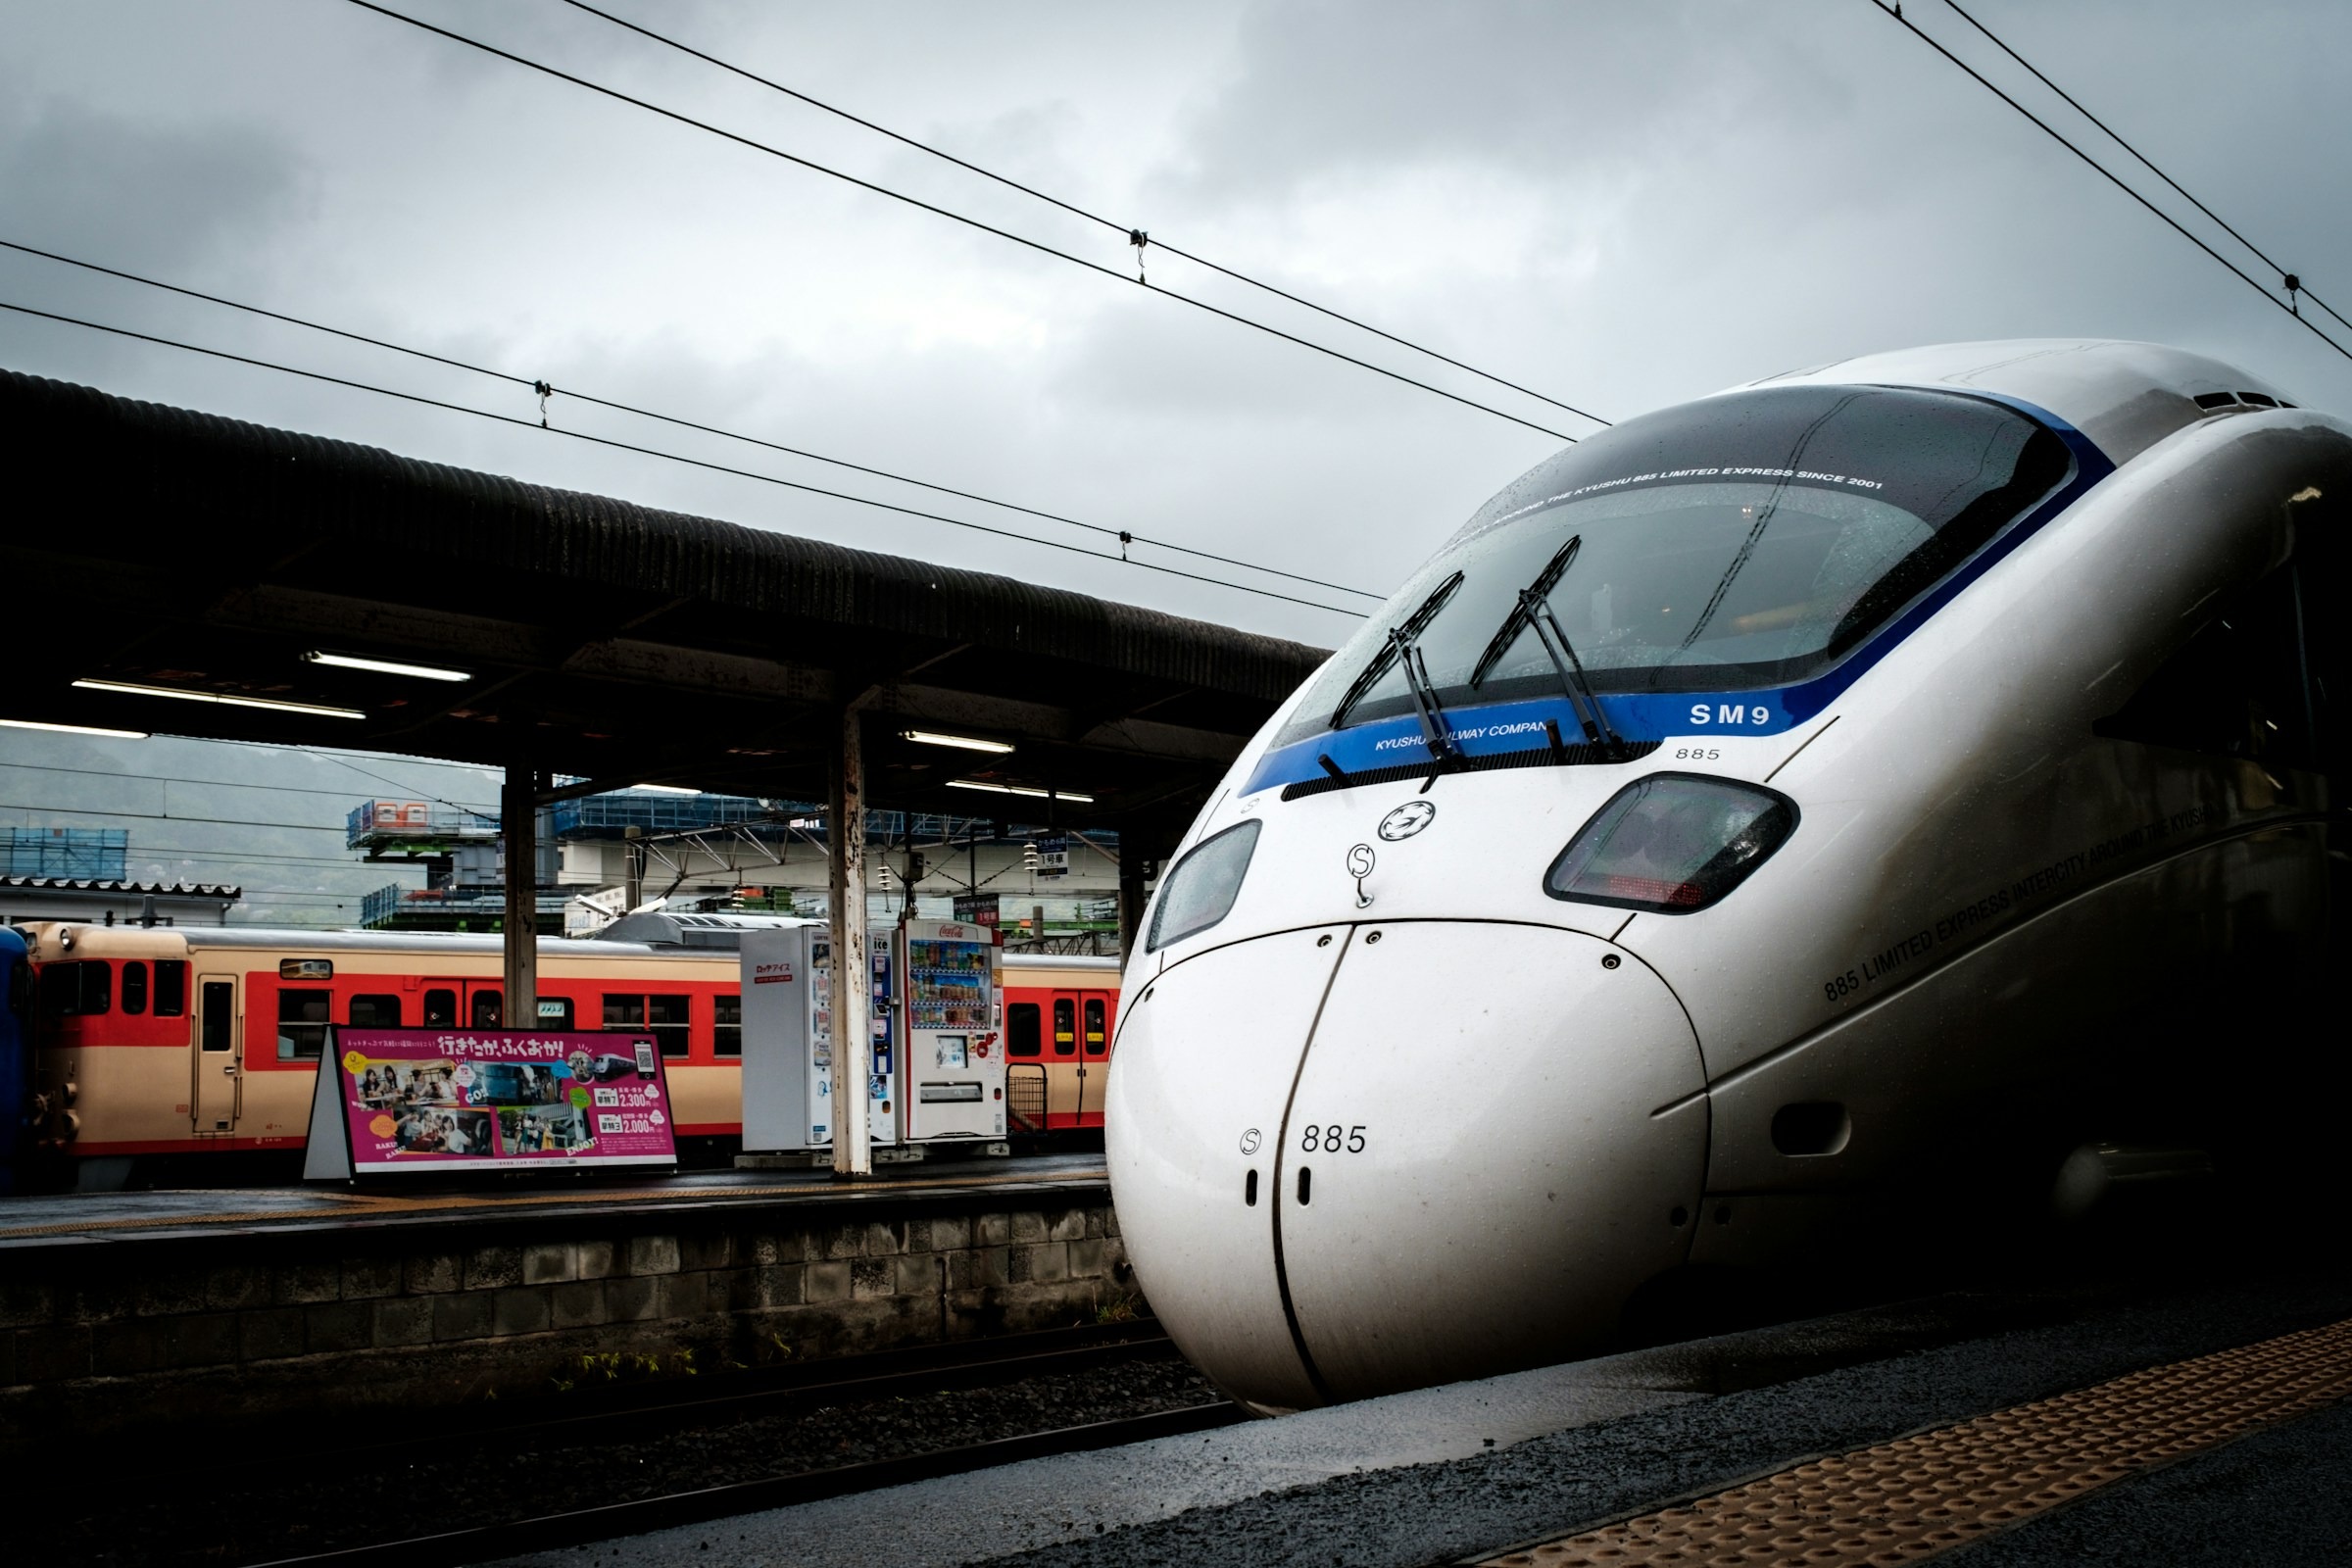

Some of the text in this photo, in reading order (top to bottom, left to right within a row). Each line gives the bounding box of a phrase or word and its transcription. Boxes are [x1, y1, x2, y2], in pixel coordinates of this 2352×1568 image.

[1547, 491, 1573, 504] THE
[1573, 477, 1631, 496] KYUSHU
[1633, 472, 1658, 483] 885
[1659, 468, 1719, 479] LIMITED
[1721, 467, 1794, 478] EXPRESS
[1795, 470, 1846, 484] SINCE
[1846, 477, 1883, 491] 2001
[1690, 704, 1769, 726] SM9
[1489, 721, 1547, 737] COMPAN
[1675, 749, 1720, 760] 885
[1041, 854, 1064, 864] 1号車
[1825, 970, 1859, 1002] 885
[1862, 930, 1933, 982] LIMITED
[1936, 890, 2010, 942] EXPRESS
[2012, 852, 2084, 902] INTERCITY
[2089, 829, 2143, 866] AROUND
[2144, 819, 2170, 843] THE
[1301, 1125, 1366, 1153] 885
